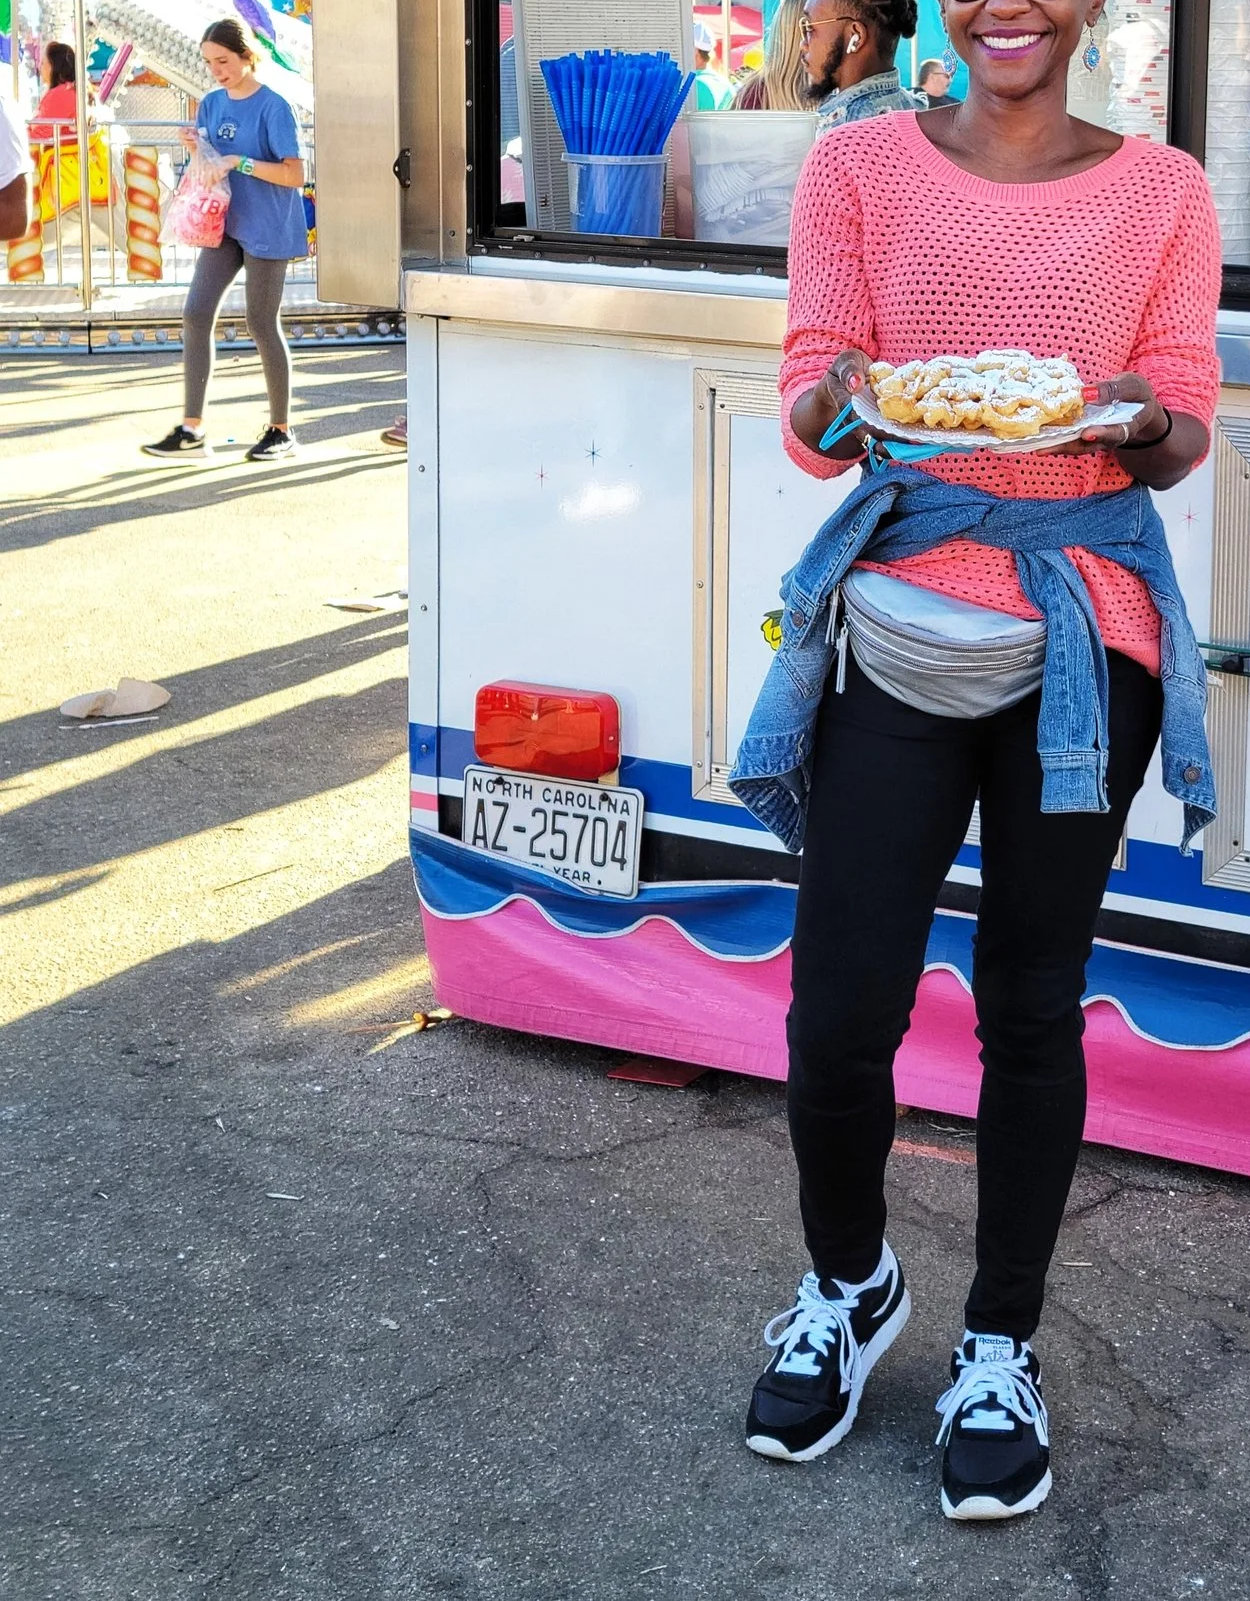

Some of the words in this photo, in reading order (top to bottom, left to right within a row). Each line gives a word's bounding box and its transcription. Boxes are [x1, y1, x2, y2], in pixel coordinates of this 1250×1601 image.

[472, 776, 533, 800] NORTH
[471, 798, 627, 872] AZ-25704
[553, 866, 591, 884] YEAR
